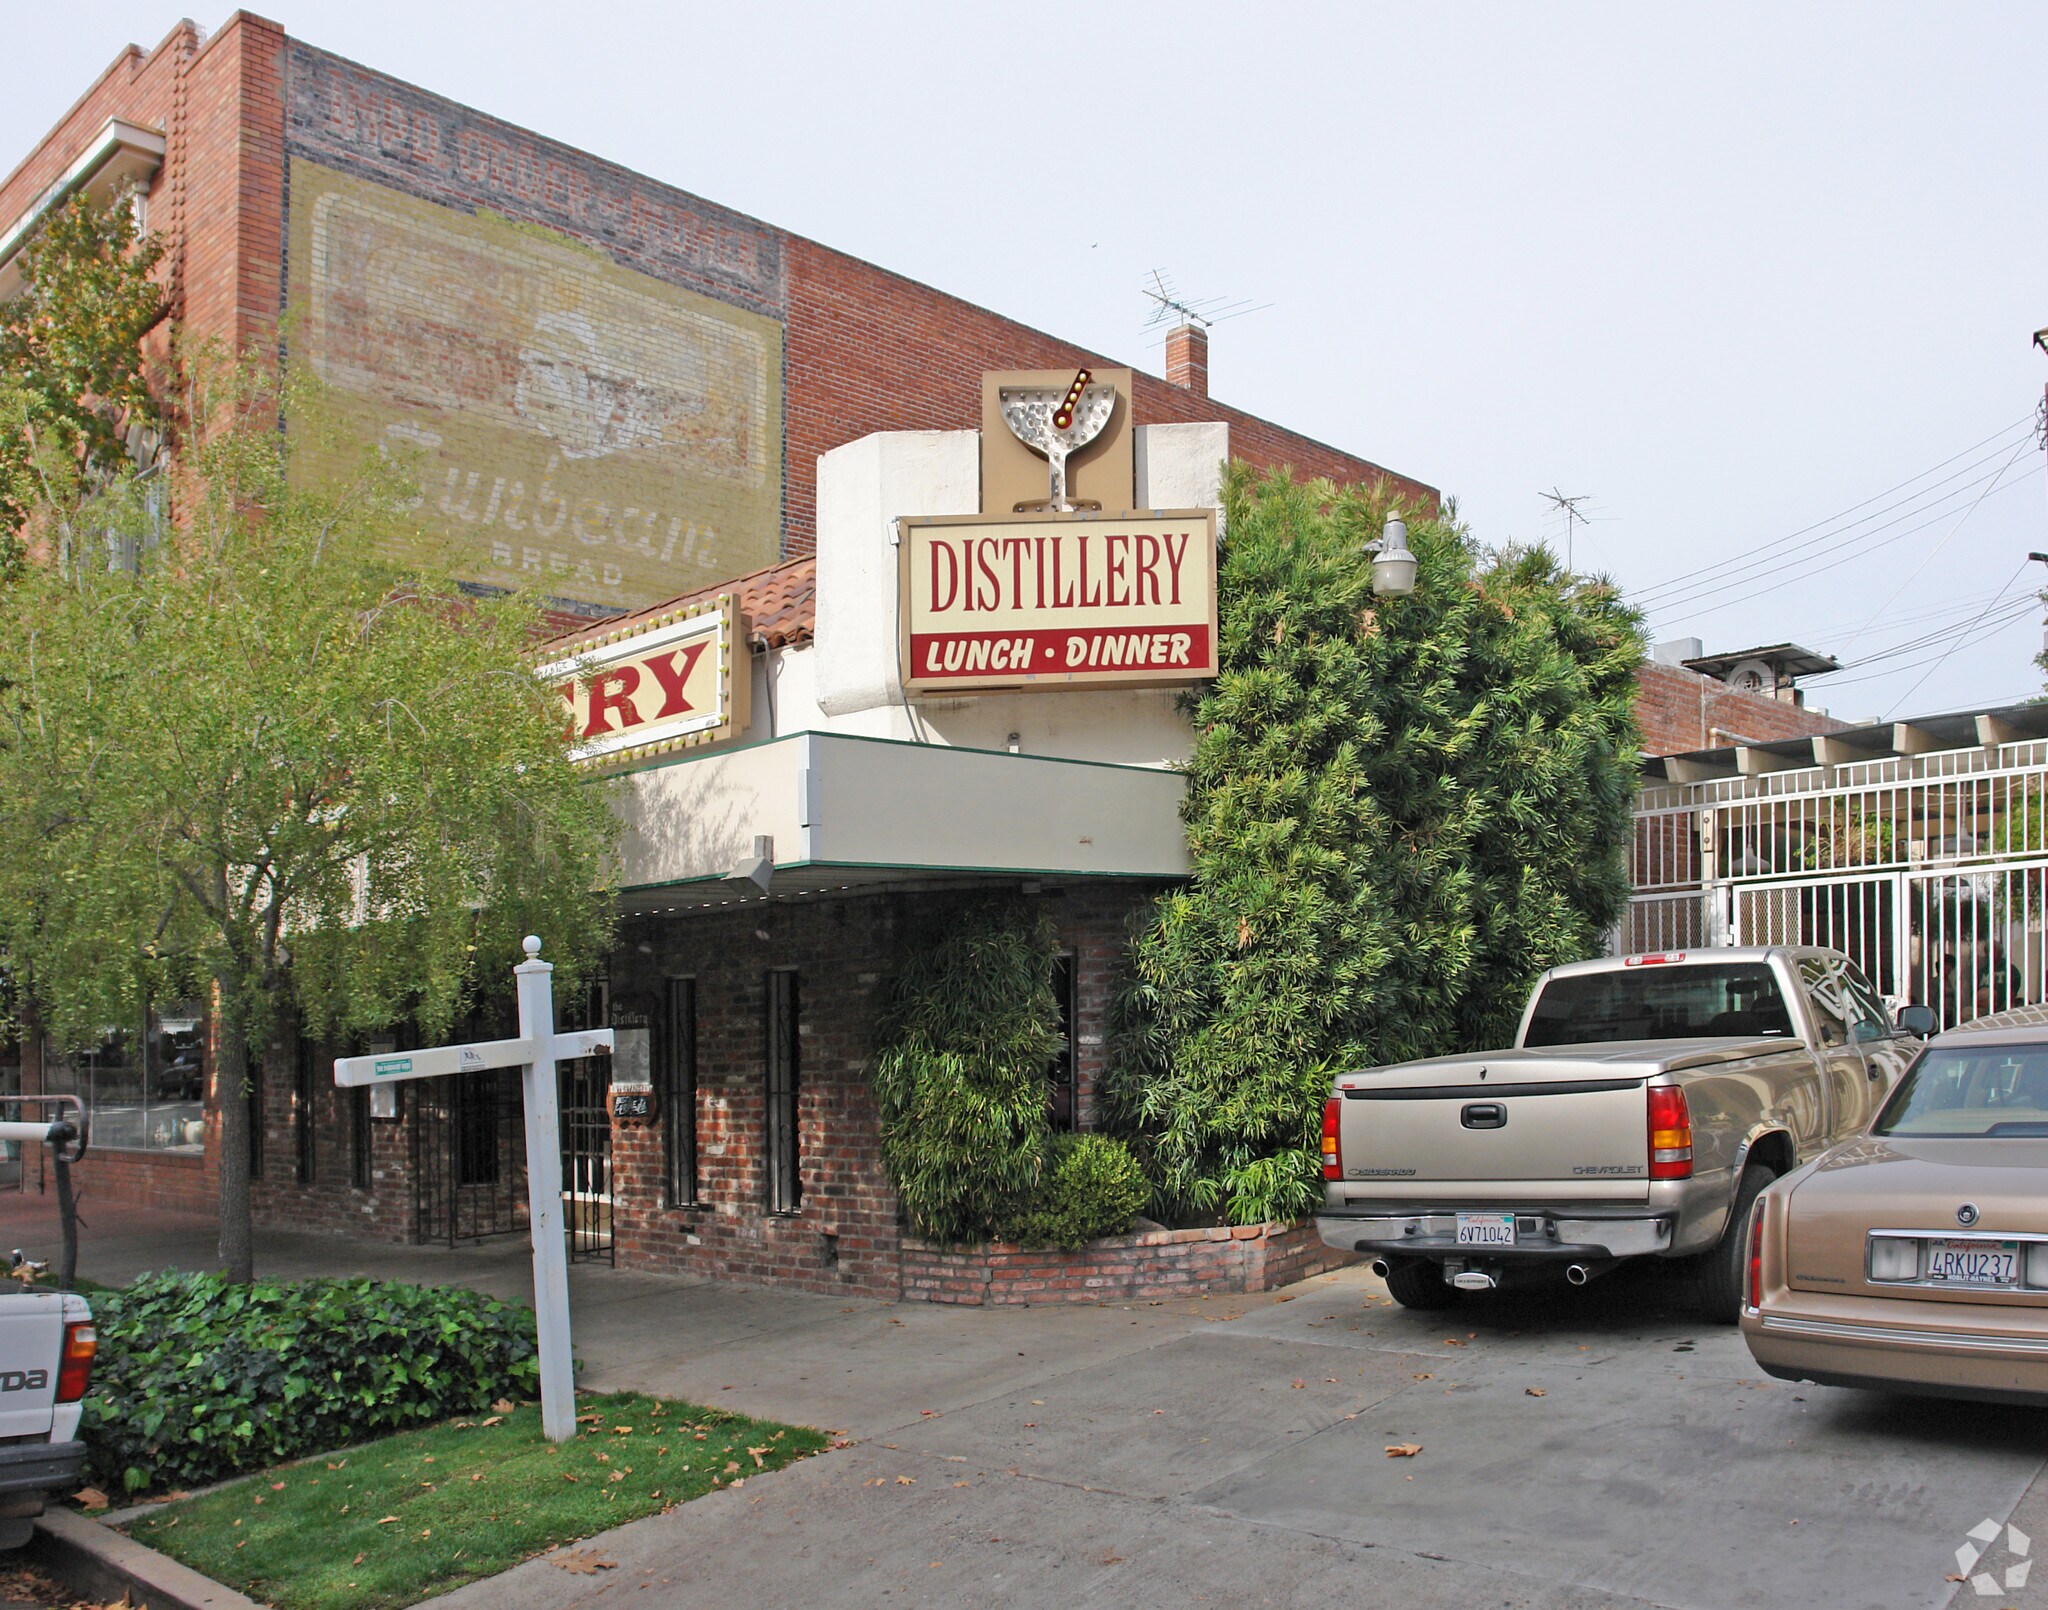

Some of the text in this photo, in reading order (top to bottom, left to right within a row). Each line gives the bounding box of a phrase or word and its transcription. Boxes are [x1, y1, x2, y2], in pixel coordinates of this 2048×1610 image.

[492, 540, 623, 586] BREAD
[929, 533, 1190, 613] DISTILLERY
[926, 632, 1192, 673] LUNCH DINNER
[1573, 1165, 1643, 1175] CHEVROLET
[1460, 1226, 1511, 1243] 6V71042
[1947, 1240, 2001, 1252] California
[1933, 1252, 2013, 1277] 4RKU237
